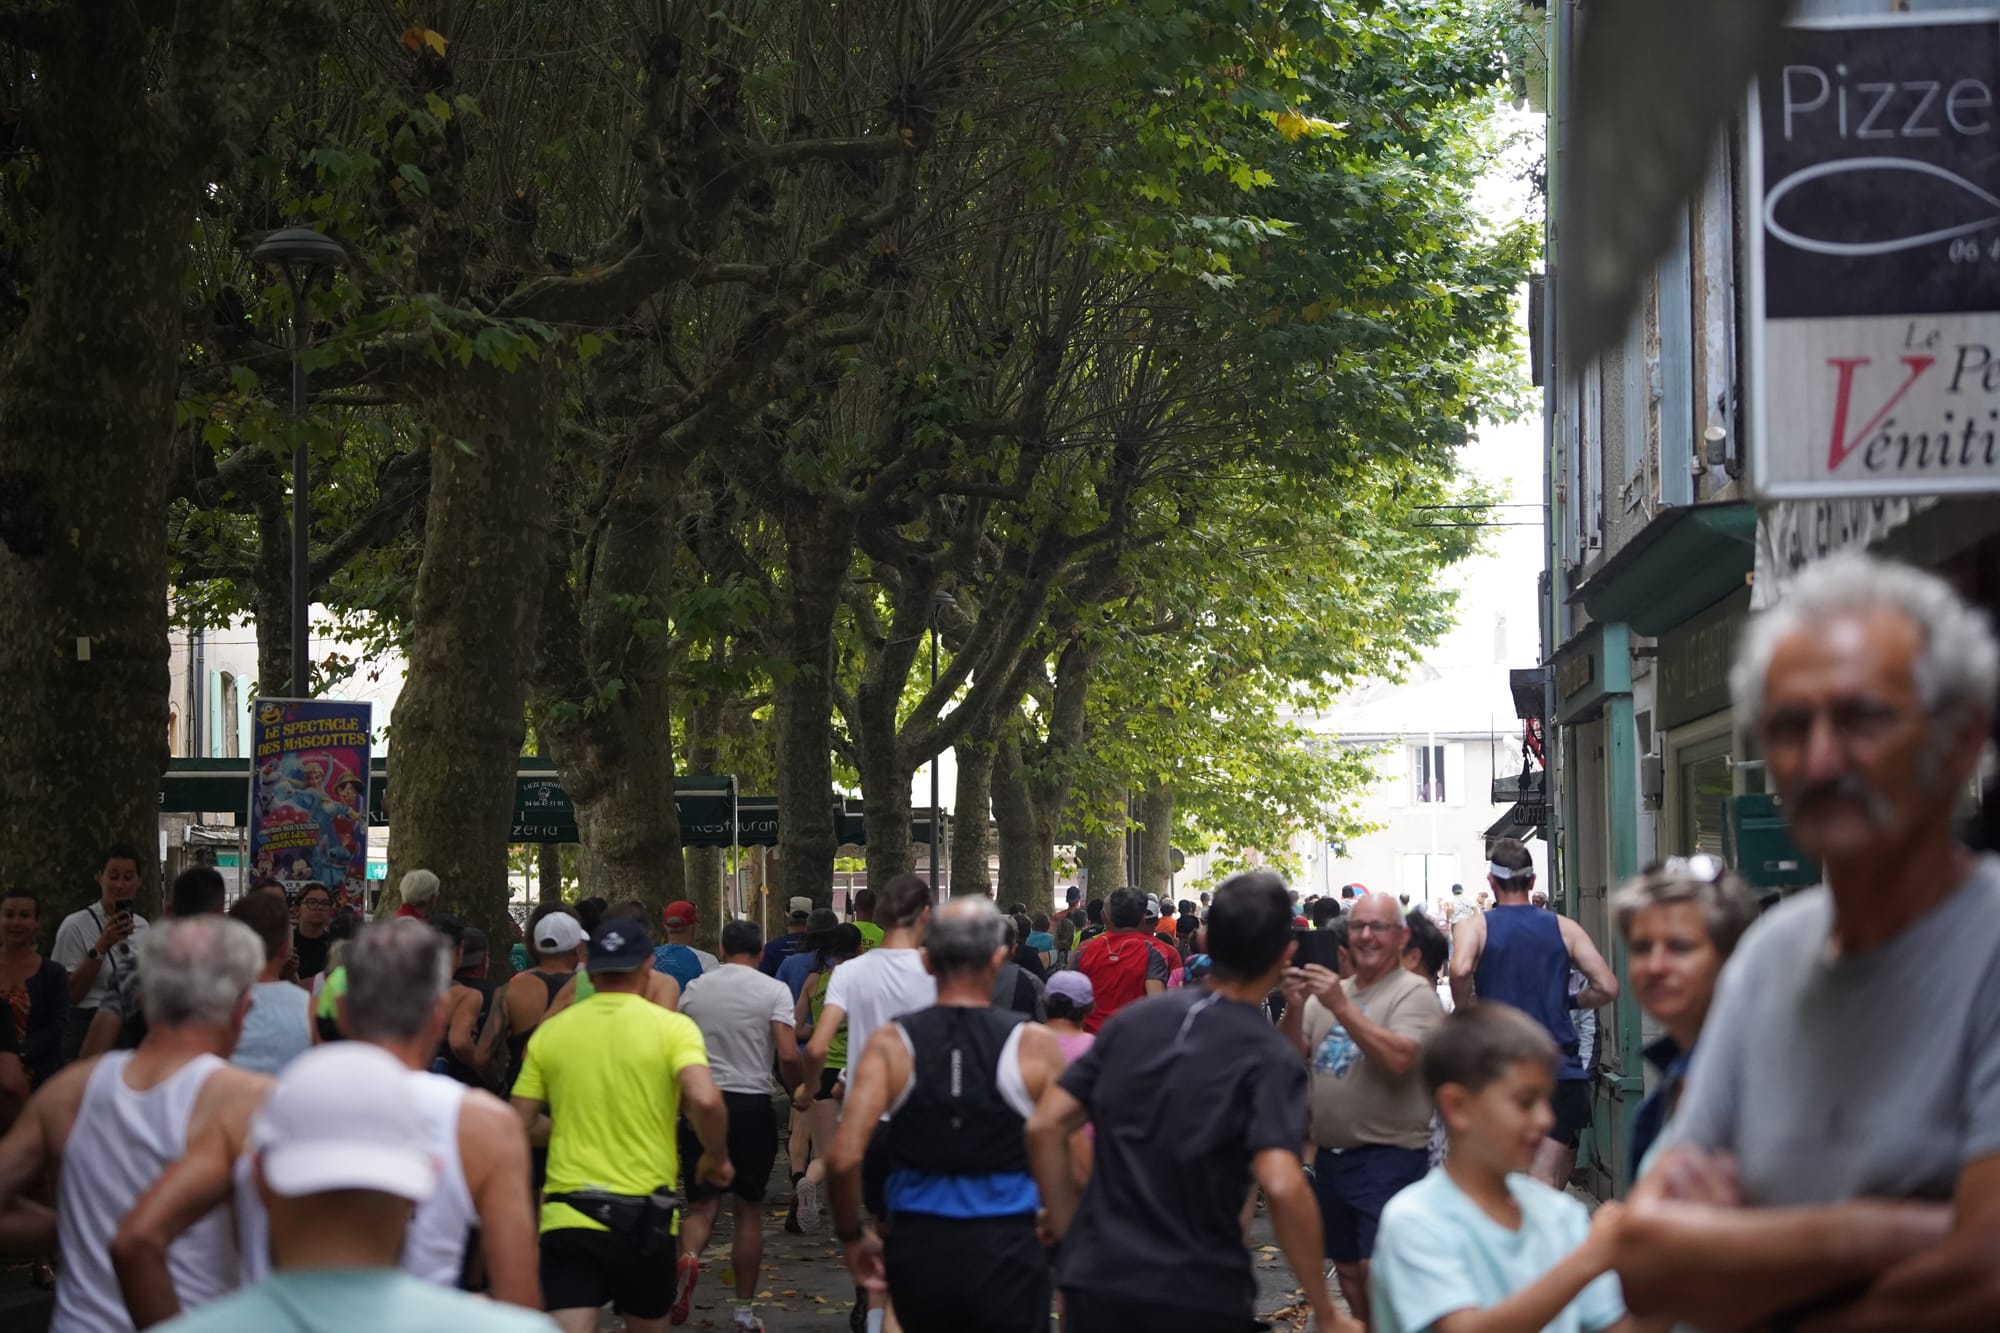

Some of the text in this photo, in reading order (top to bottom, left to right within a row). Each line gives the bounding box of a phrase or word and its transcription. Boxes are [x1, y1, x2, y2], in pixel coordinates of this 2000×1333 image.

[1782, 63, 1994, 142] Pizze
[1904, 321, 1941, 349] Le
[1826, 354, 1999, 474] Véniti
[264, 718, 359, 740] LE SPECTACLE
[257, 733, 366, 757] DES MASCOTTES
